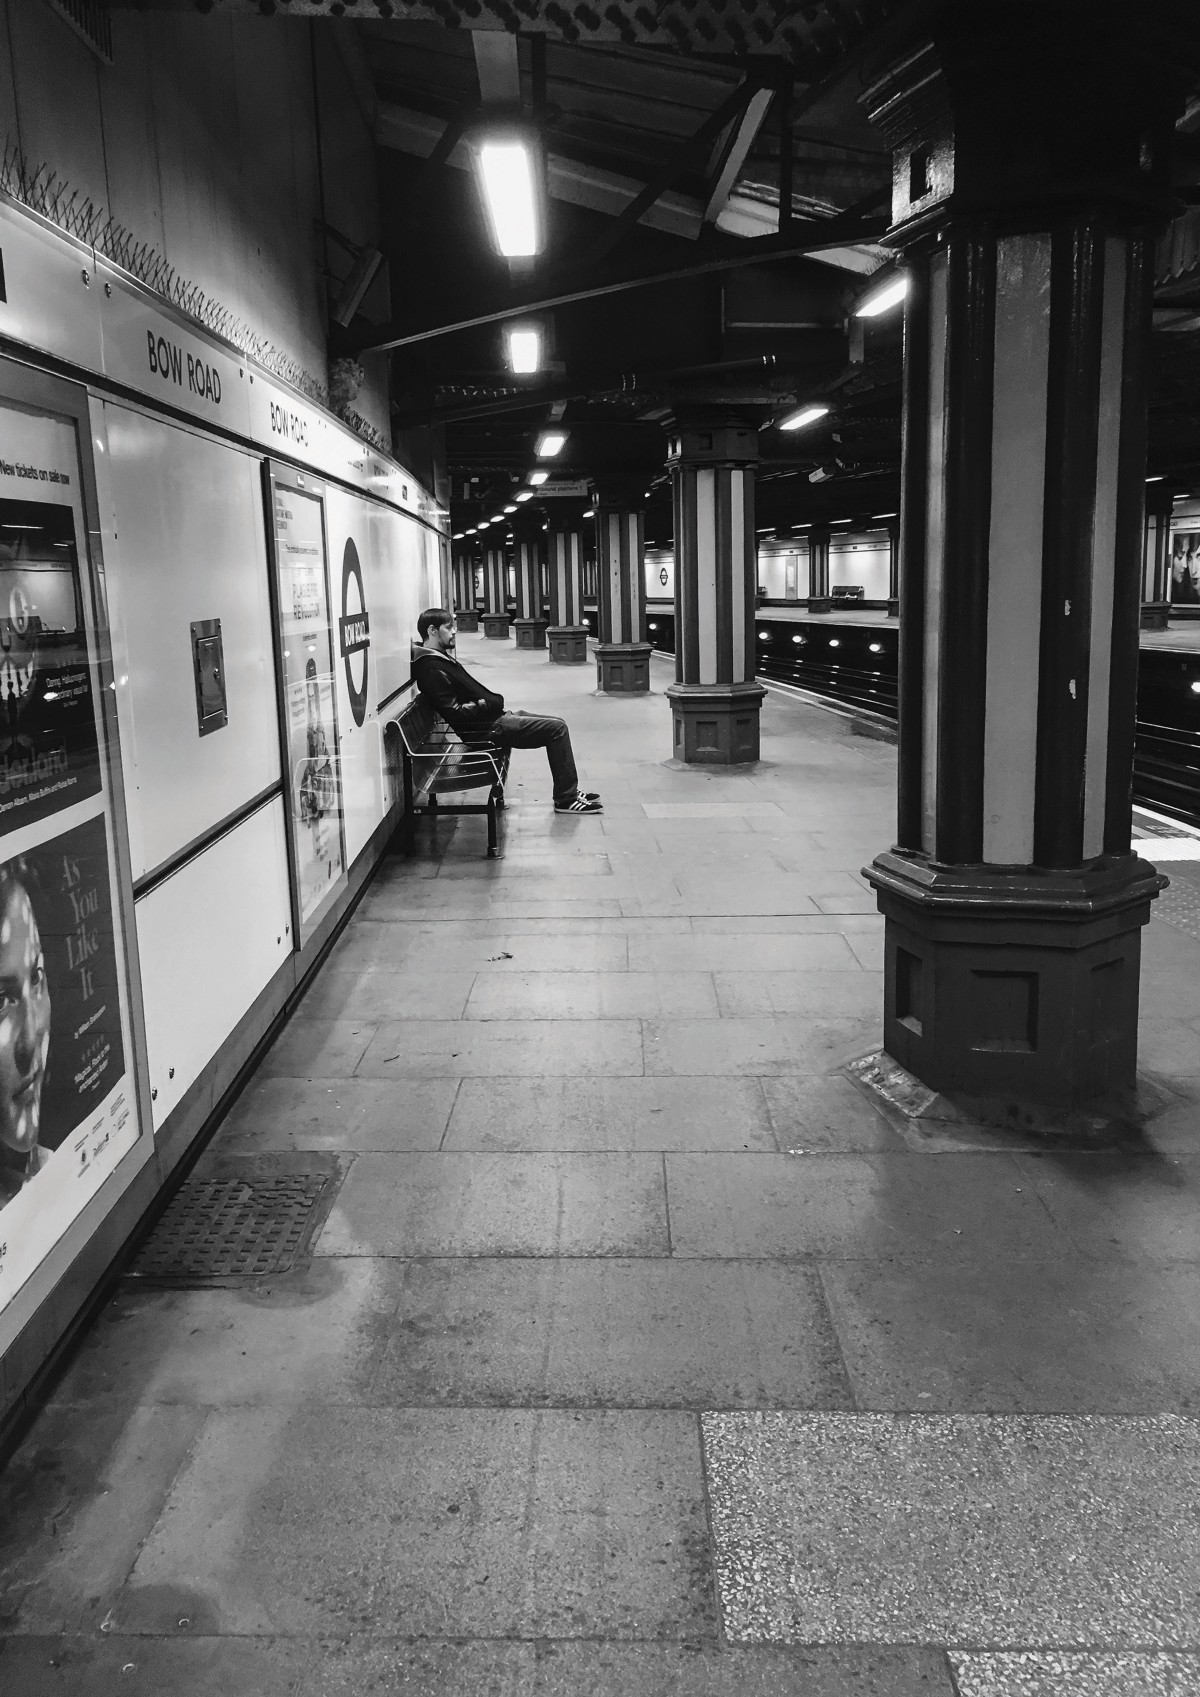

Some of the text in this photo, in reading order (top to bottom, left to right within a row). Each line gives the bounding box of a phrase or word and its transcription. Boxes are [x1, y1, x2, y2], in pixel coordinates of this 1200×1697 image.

[147, 329, 222, 404] BOW ROAD
[270, 401, 290, 437] BOW
[0, 459, 15, 476] New
[16, 462, 39, 481] tickets
[39, 470, 48, 482] on
[49, 469, 60, 484] sale
[344, 623, 355, 647] BOW
[62, 855, 81, 890] As
[69, 888, 99, 926] You
[66, 923, 99, 970] Like
[80, 966, 94, 1001] It
